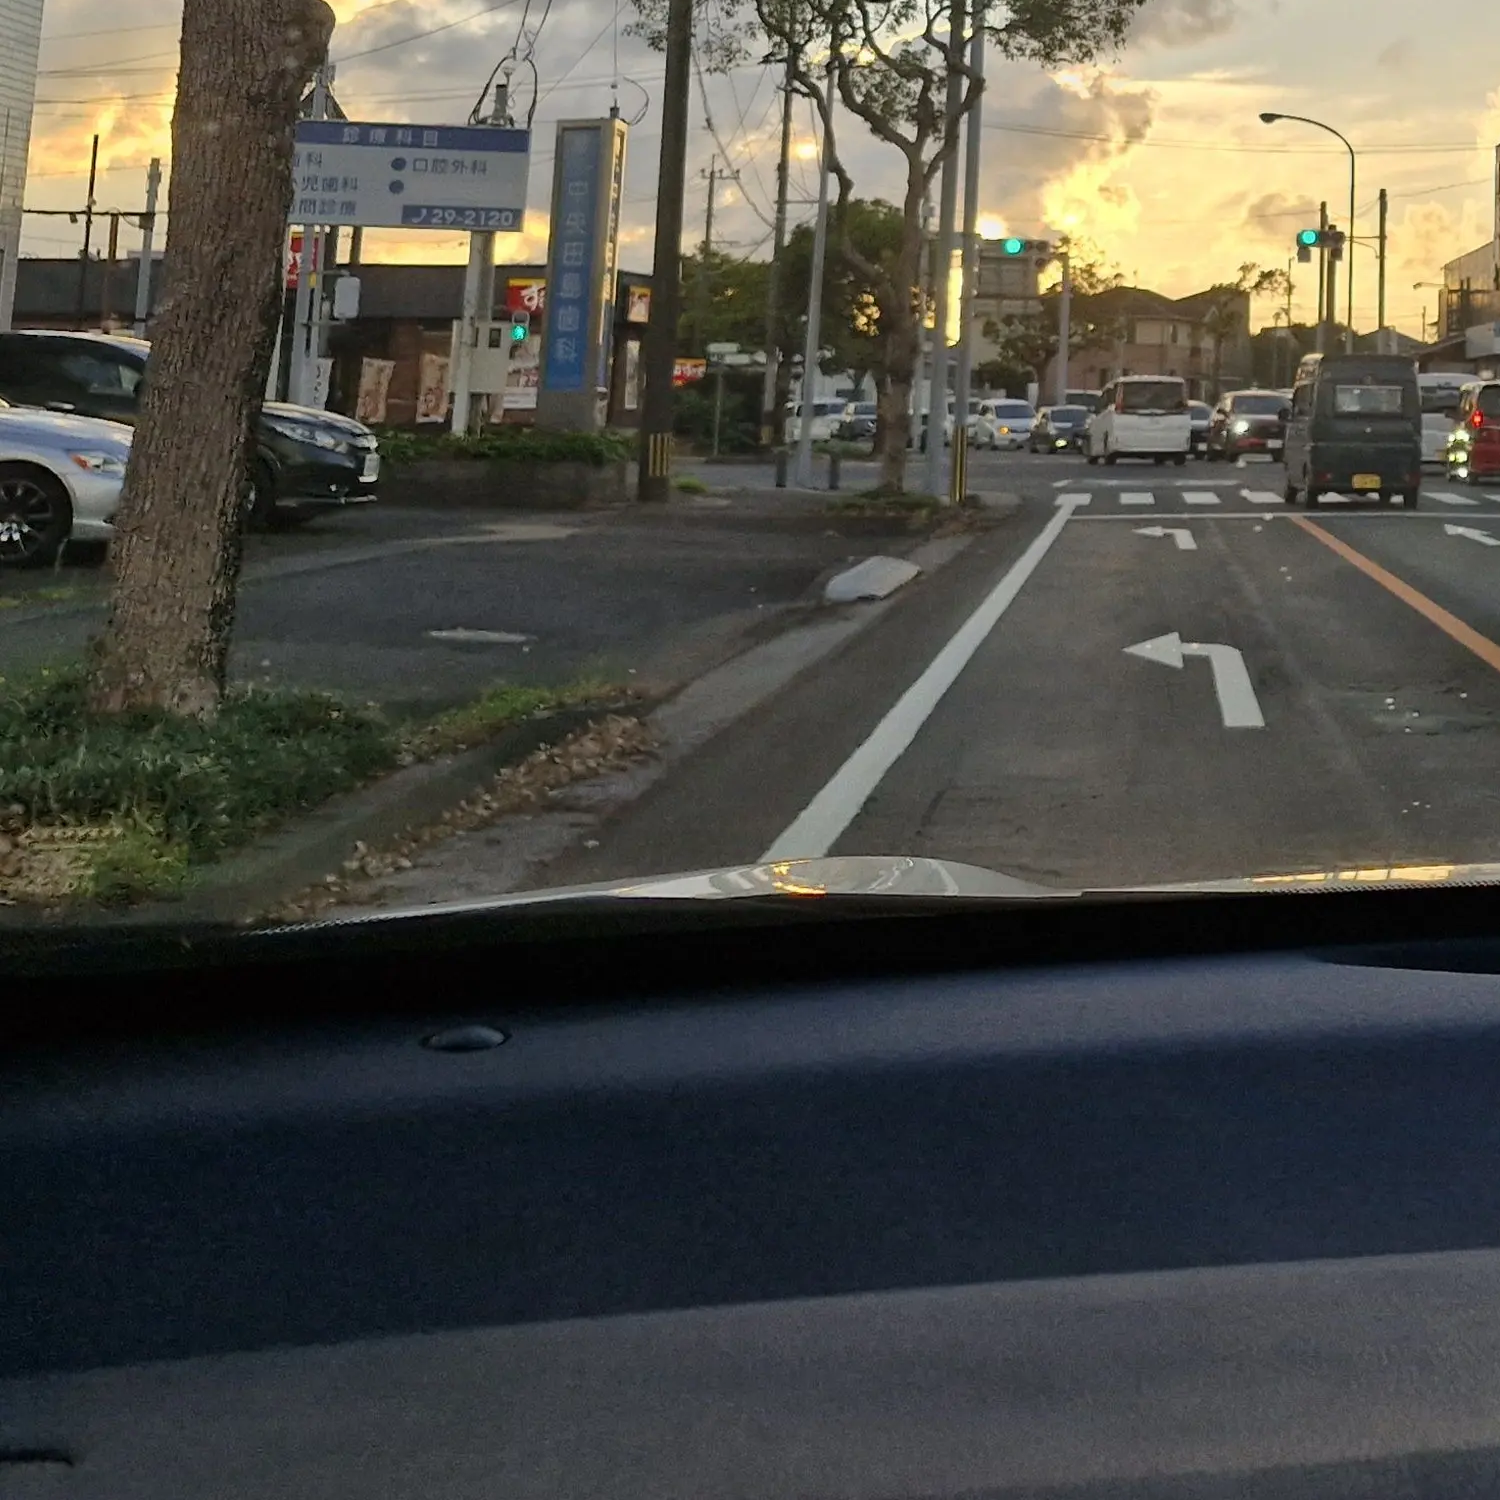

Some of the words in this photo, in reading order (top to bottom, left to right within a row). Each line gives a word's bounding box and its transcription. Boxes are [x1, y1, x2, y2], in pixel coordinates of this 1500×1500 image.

[341, 126, 438, 147] 診療科目
[412, 158, 488, 175] 口腔外科
[431, 207, 514, 226] 29-2120
